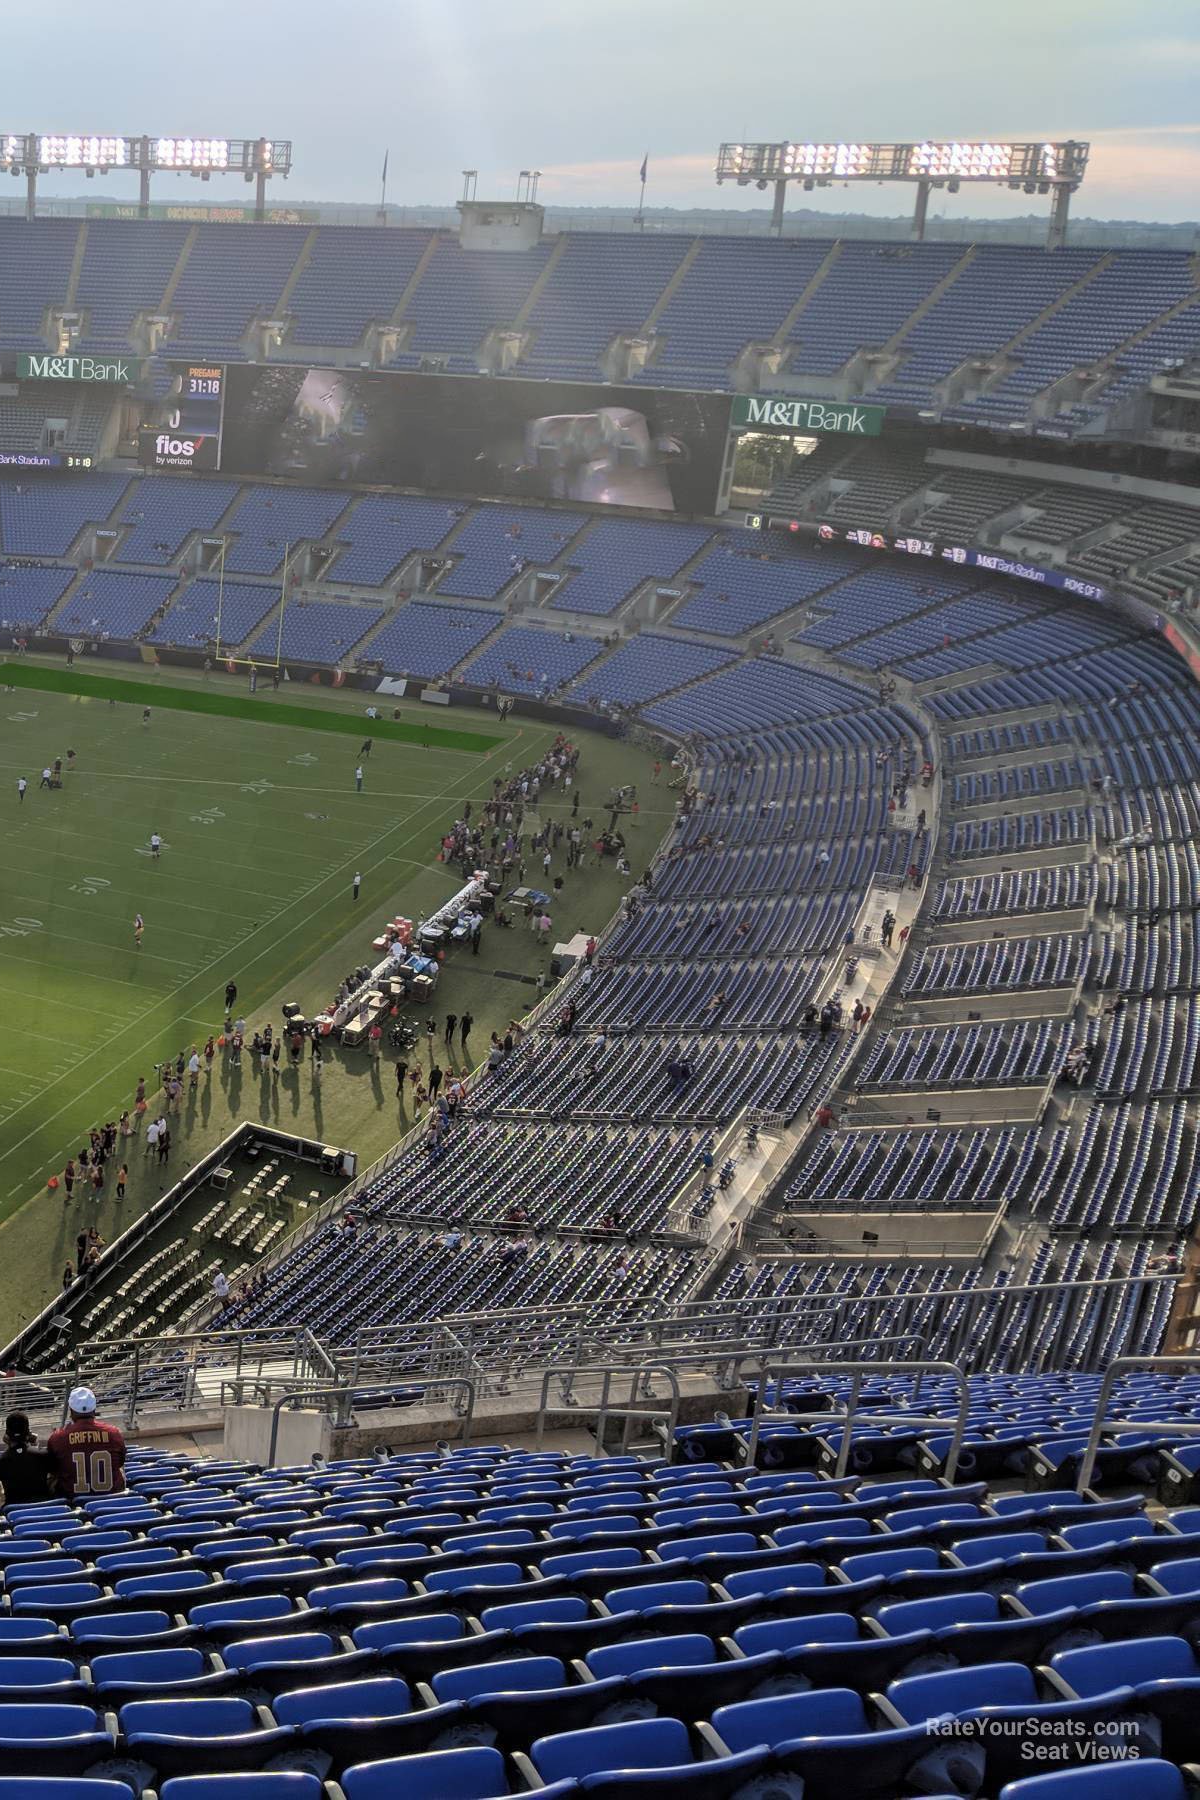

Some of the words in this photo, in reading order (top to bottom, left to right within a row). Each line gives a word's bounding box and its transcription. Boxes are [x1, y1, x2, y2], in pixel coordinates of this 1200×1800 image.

[28, 356, 79, 379] M&T
[81, 358, 128, 380] Bank
[189, 367, 222, 378] PREGAME
[190, 378, 220, 393] 31:18
[746, 398, 807, 427] M&T
[807, 403, 866, 433] Bank
[155, 435, 195, 456] fios
[17, 455, 50, 466] Stadium
[156, 456, 165, 466] by
[166, 457, 193, 466] verizon
[976, 553, 1000, 570] M&T
[998, 558, 1018, 574] Bank
[1015, 563, 1046, 582] Stadium
[1064, 577, 1086, 594] HOME
[1084, 583, 1096, 597] OF
[189, 808, 226, 824] 30
[69, 877, 112, 895] 50
[0, 917, 44, 937] 40
[68, 1431, 100, 1445] GRIFFIN
[72, 1450, 113, 1494] 10
